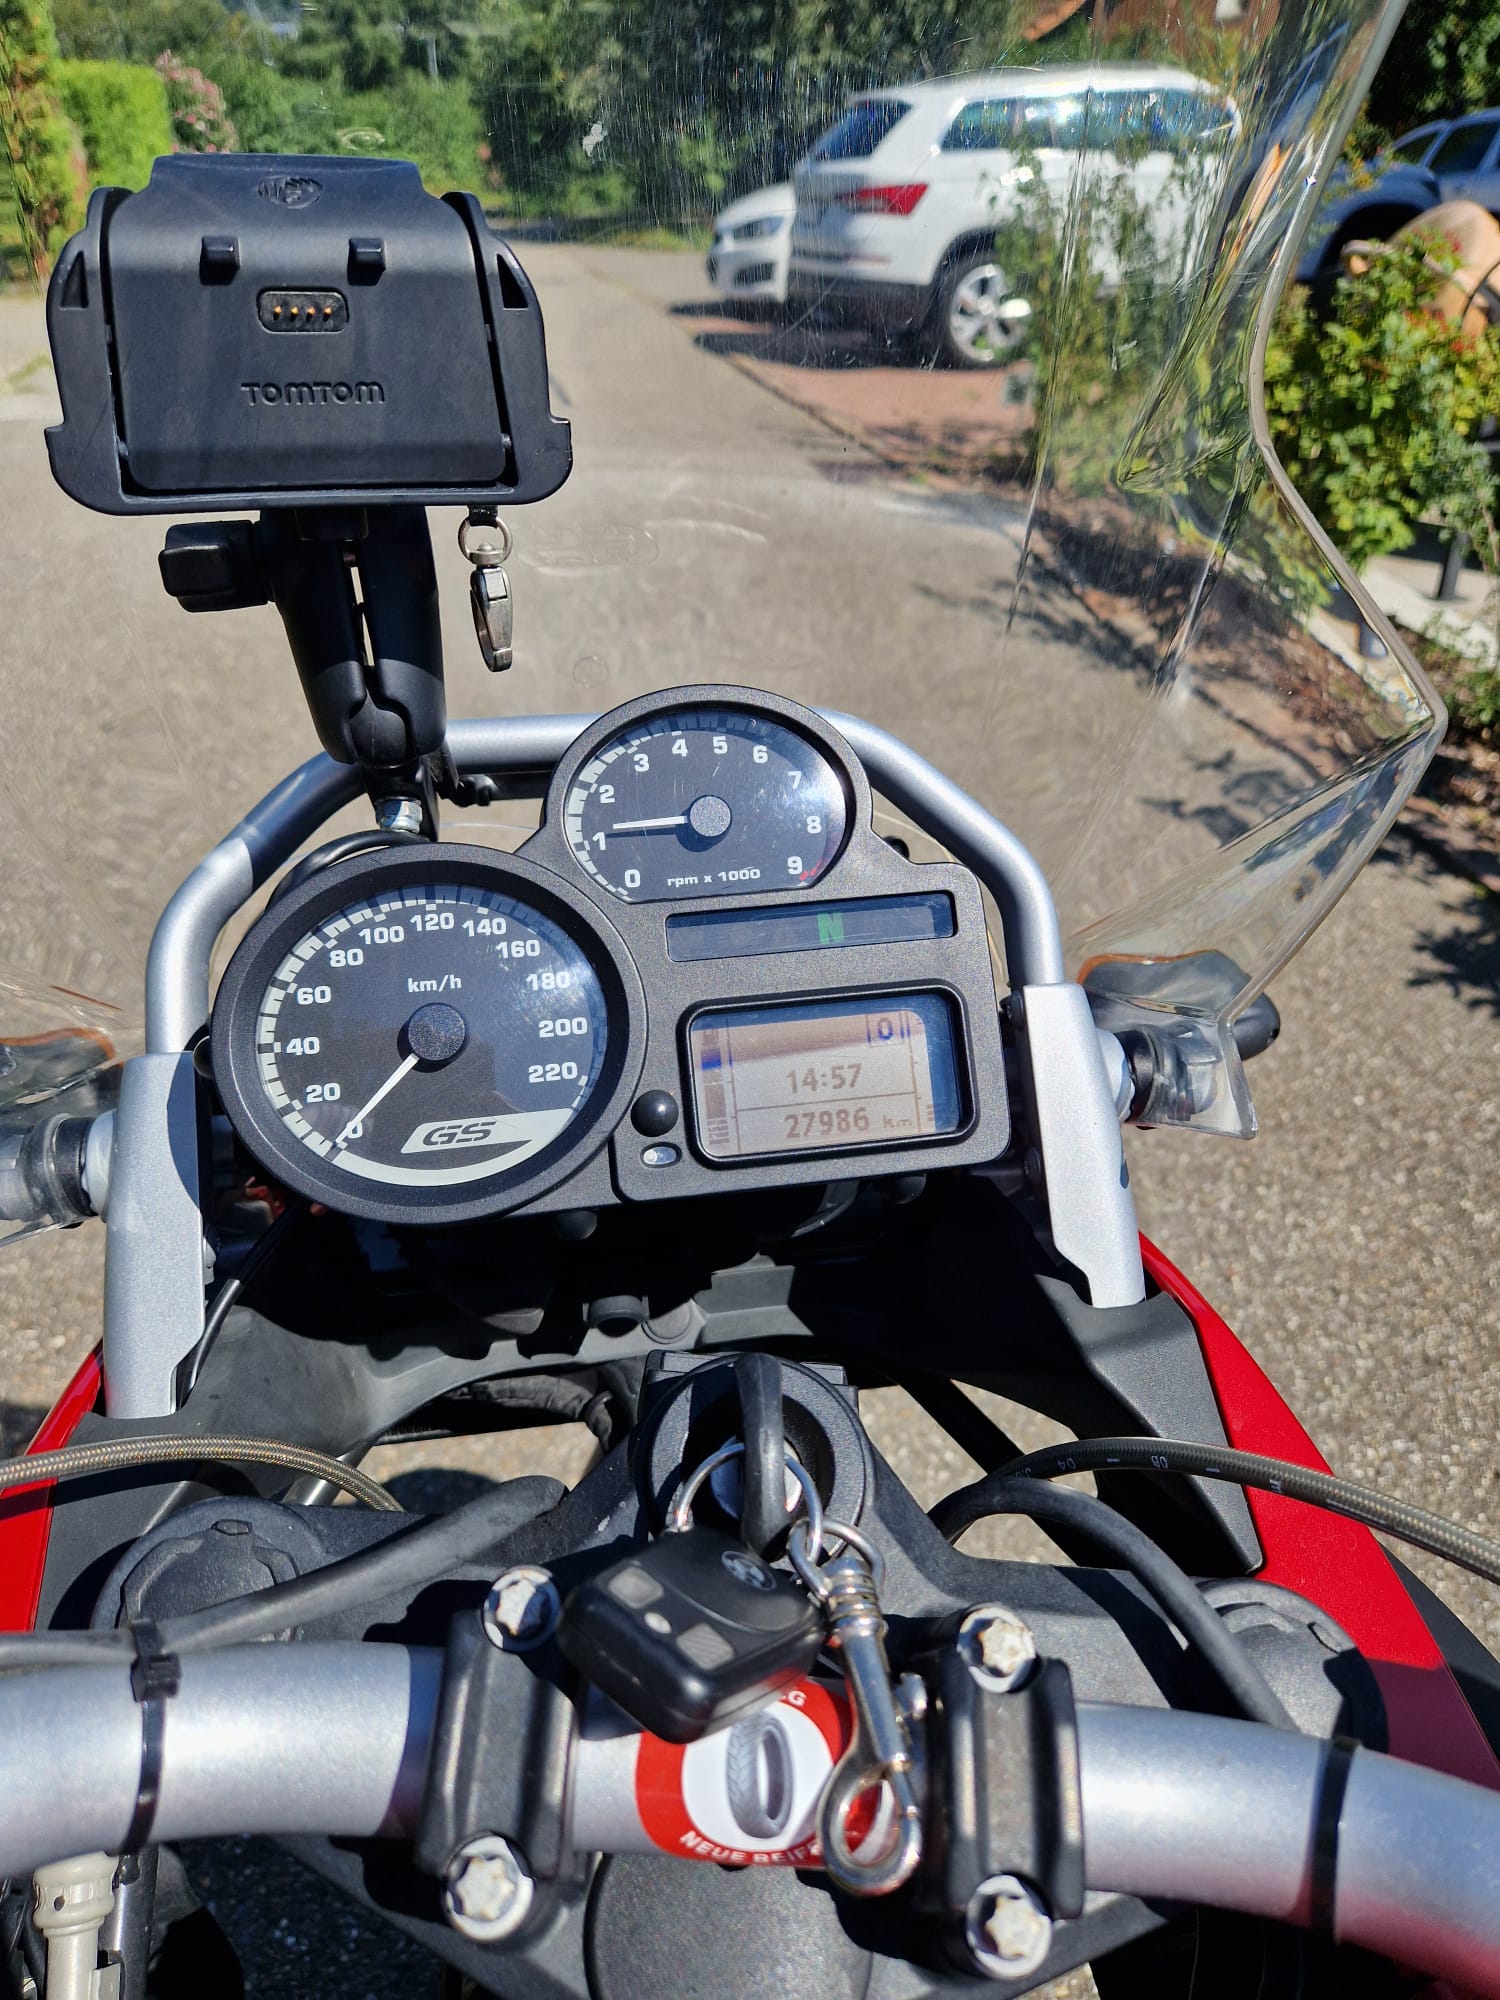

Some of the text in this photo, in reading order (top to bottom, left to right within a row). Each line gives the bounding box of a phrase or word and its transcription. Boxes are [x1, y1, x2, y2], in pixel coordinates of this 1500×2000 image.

[671, 738, 688, 757] 4
[713, 736, 728, 754] 5
[752, 745, 768, 764] 6
[633, 754, 649, 772] 3
[788, 771, 802, 789] 7
[599, 784, 615, 804] 2
[806, 815, 822, 834] 8
[592, 831, 606, 850] 1
[787, 856, 802, 874] 9
[624, 869, 640, 888] 0
[667, 868, 760, 887] rpm x 1000
[410, 912, 454, 931] 120
[461, 918, 507, 936] 140
[817, 912, 844, 944] N
[358, 926, 404, 944] 100
[329, 948, 364, 968] 80
[495, 940, 540, 958] 160
[407, 974, 461, 993] km/h
[526, 972, 571, 991] 180
[297, 985, 332, 1005] 60
[538, 1017, 587, 1037] 200
[286, 1037, 320, 1056] 40
[528, 1061, 577, 1082] 220
[787, 1063, 862, 1094] 14:57
[306, 1083, 341, 1103] 20
[784, 1107, 912, 1138] 27986 km
[422, 1121, 496, 1145] GS
[679, 1830, 747, 1862] NEUE
